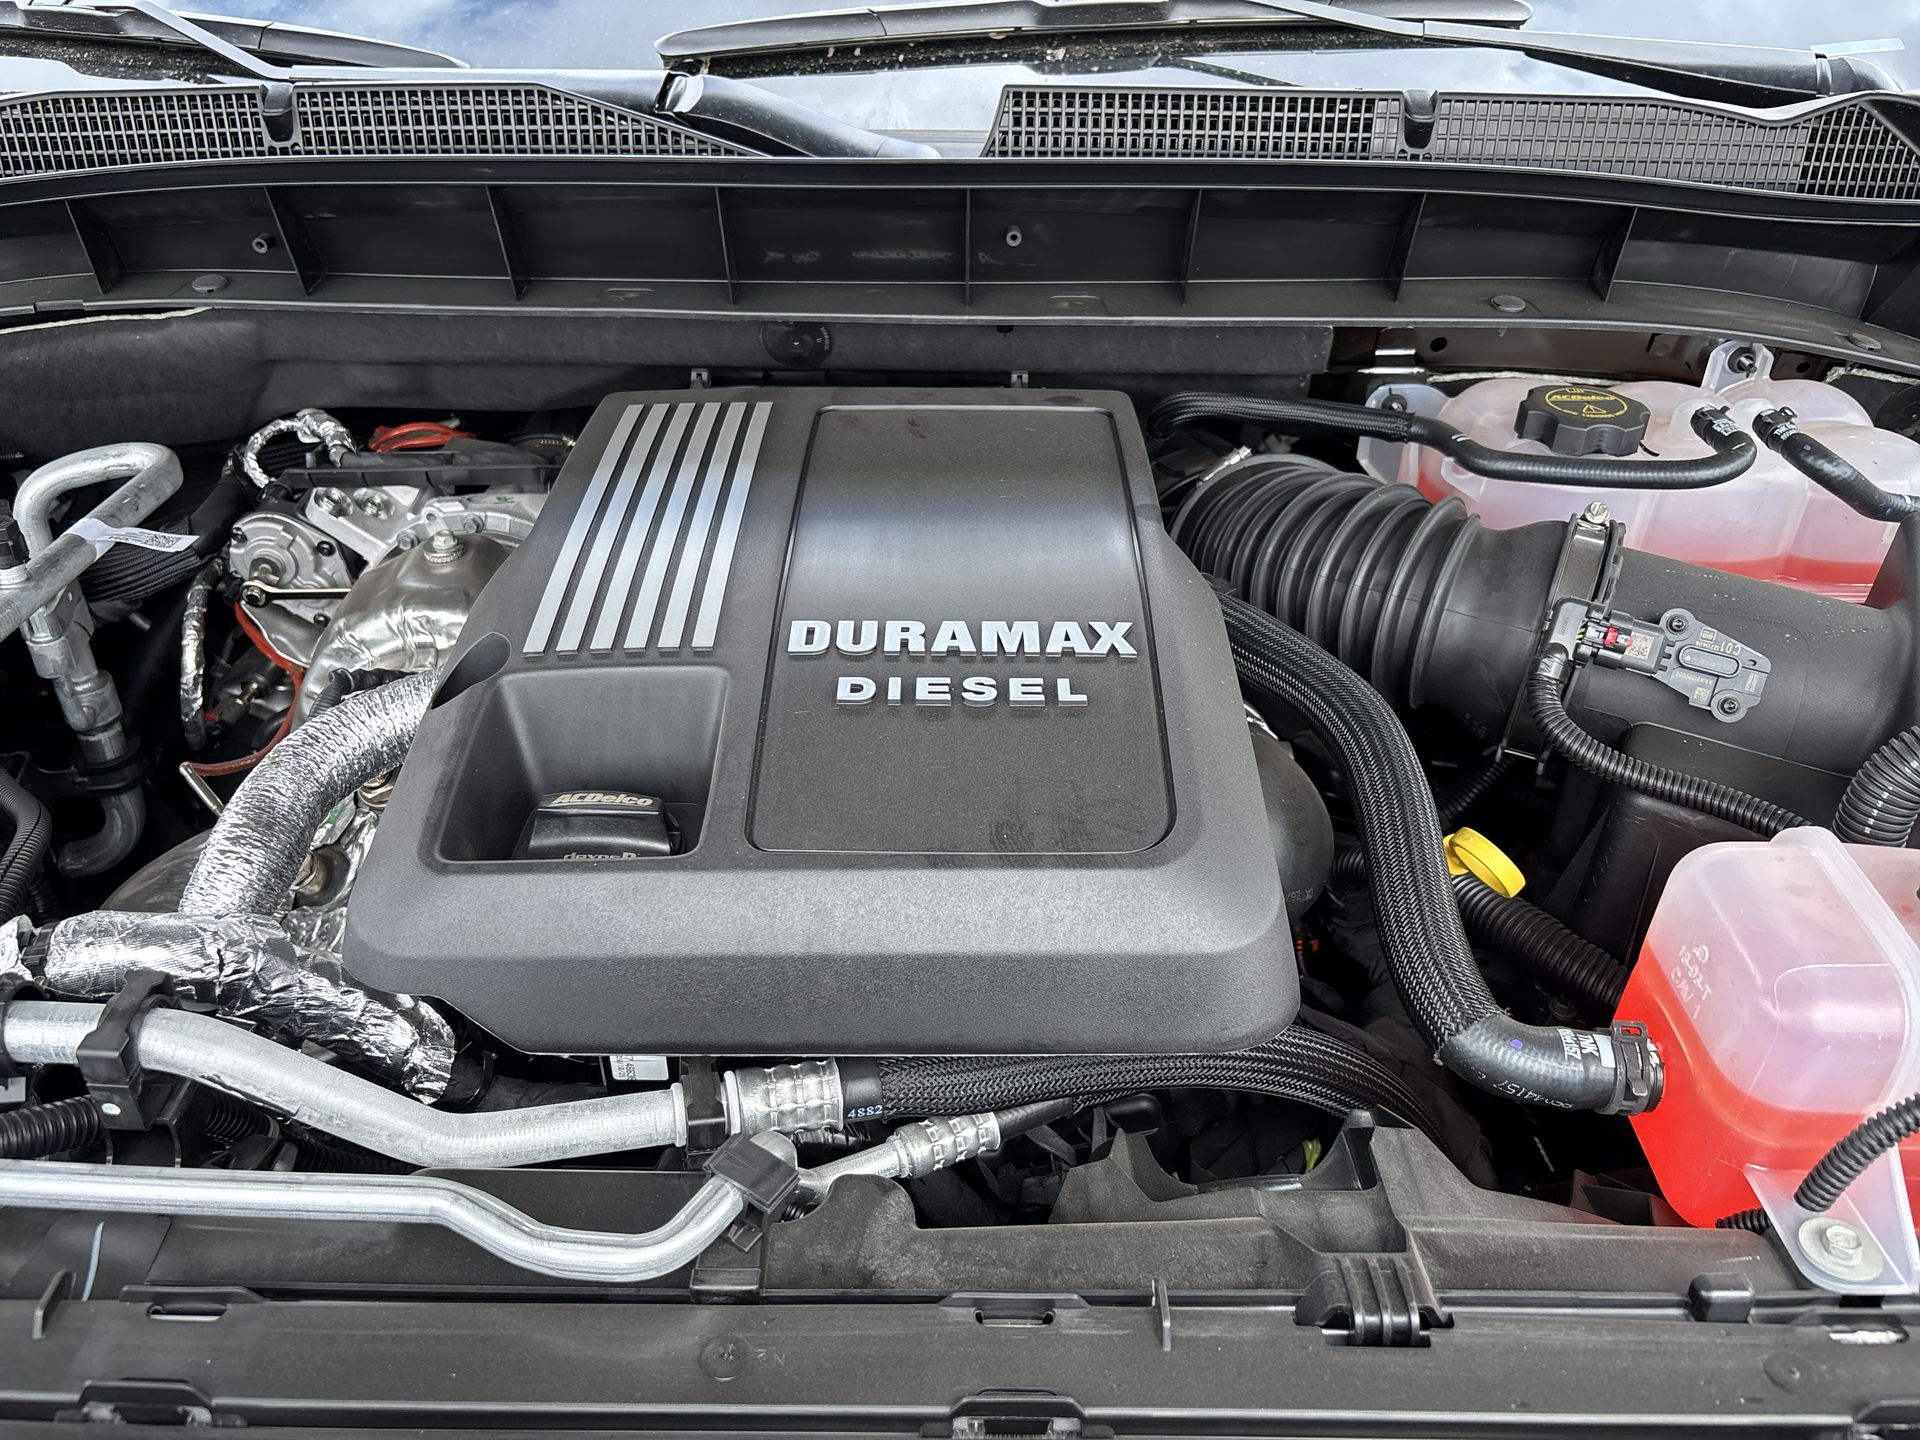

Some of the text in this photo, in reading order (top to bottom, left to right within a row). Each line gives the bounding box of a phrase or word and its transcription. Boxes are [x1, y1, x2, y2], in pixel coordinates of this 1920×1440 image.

[1549, 394, 1616, 402] ACDelco
[787, 620, 1138, 657] DURAMAX
[836, 676, 1088, 706] DIESEL
[552, 793, 654, 806] ACDelco
[1575, 1033, 1599, 1057] TNK
[847, 1104, 883, 1118] 4882
